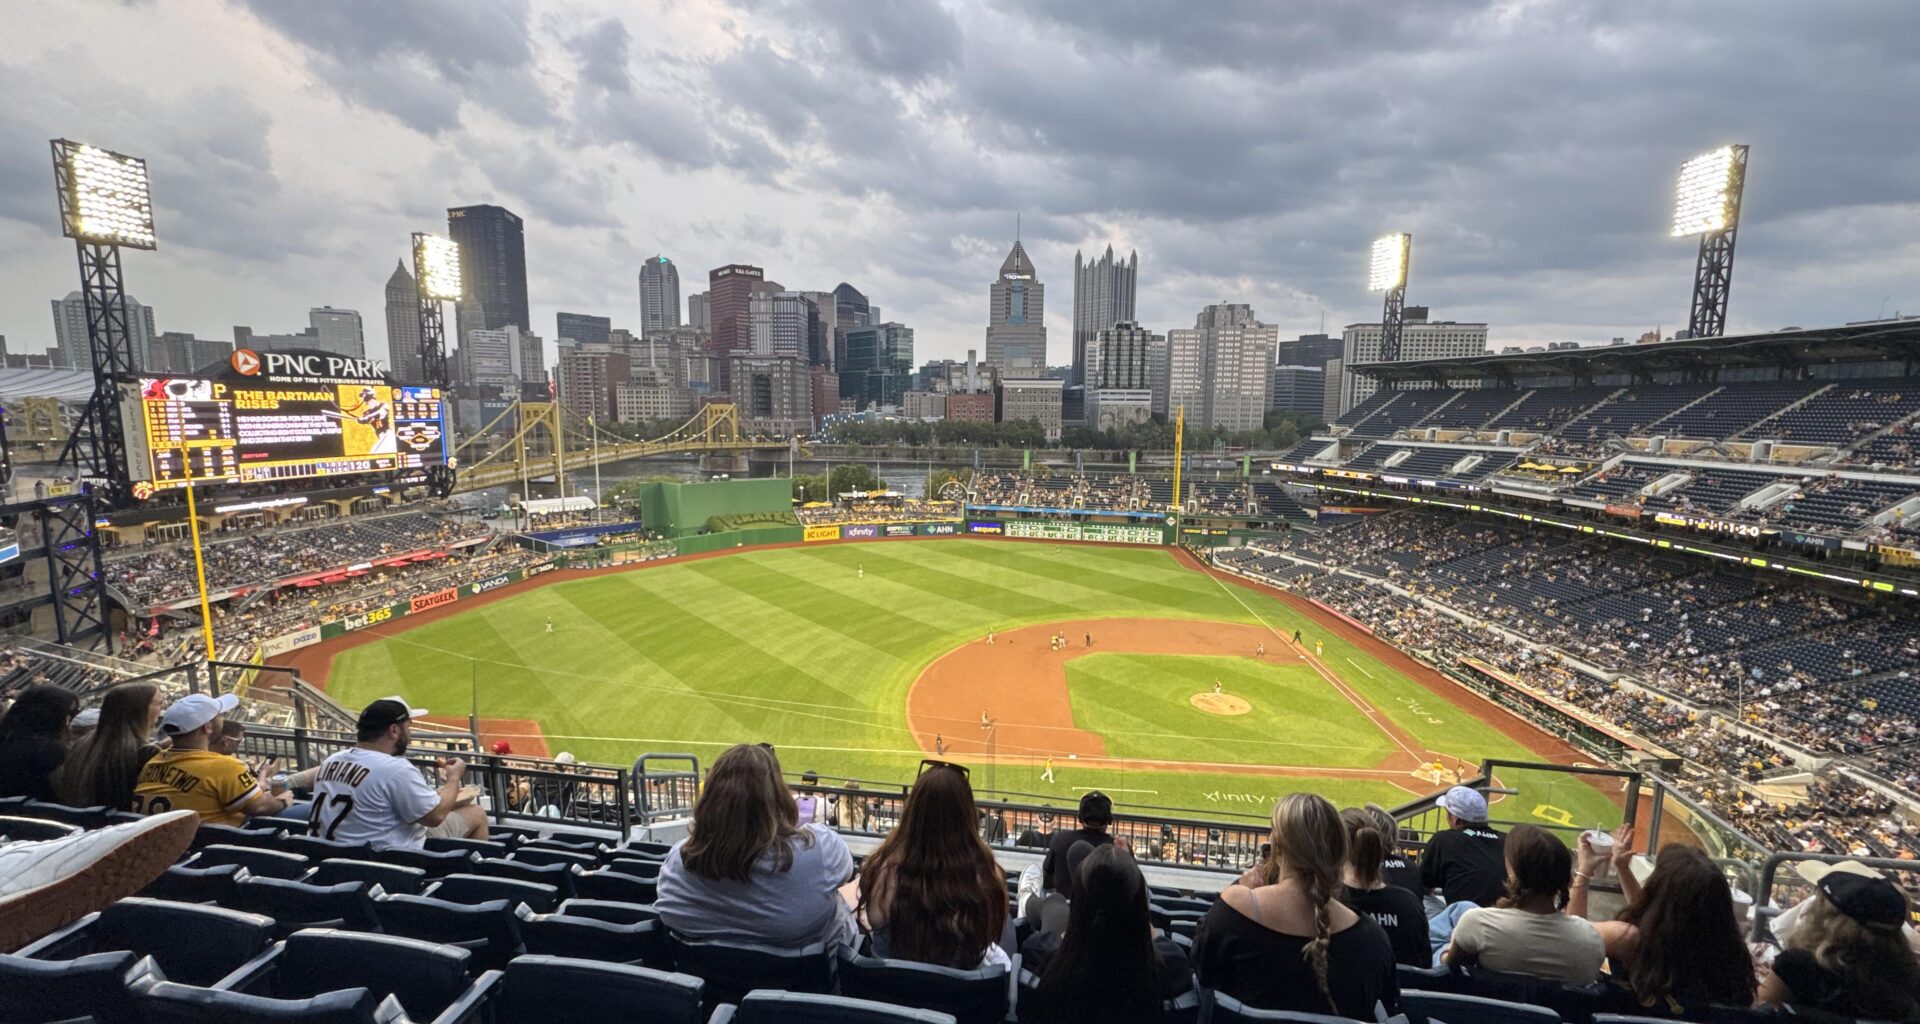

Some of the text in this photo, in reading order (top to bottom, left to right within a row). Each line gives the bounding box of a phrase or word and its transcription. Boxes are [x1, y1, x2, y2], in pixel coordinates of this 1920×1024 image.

[264, 353, 385, 379] PNC PARK
[213, 383, 227, 399] P
[234, 390, 335, 401] THE BARTMAN
[236, 399, 280, 409] RISES
[817, 530, 837, 538] LIGHT
[848, 526, 873, 536] xfinity
[1805, 537, 1825, 546] AHN
[481, 575, 509, 588] VANDA
[414, 590, 455, 611] SEATGEEK
[343, 607, 392, 631] bet365
[265, 632, 317, 653] PNC paze
[316, 761, 370, 788] LIRIANO
[1202, 790, 1265, 804] xfinity
[1384, 859, 1406, 869] AHN
